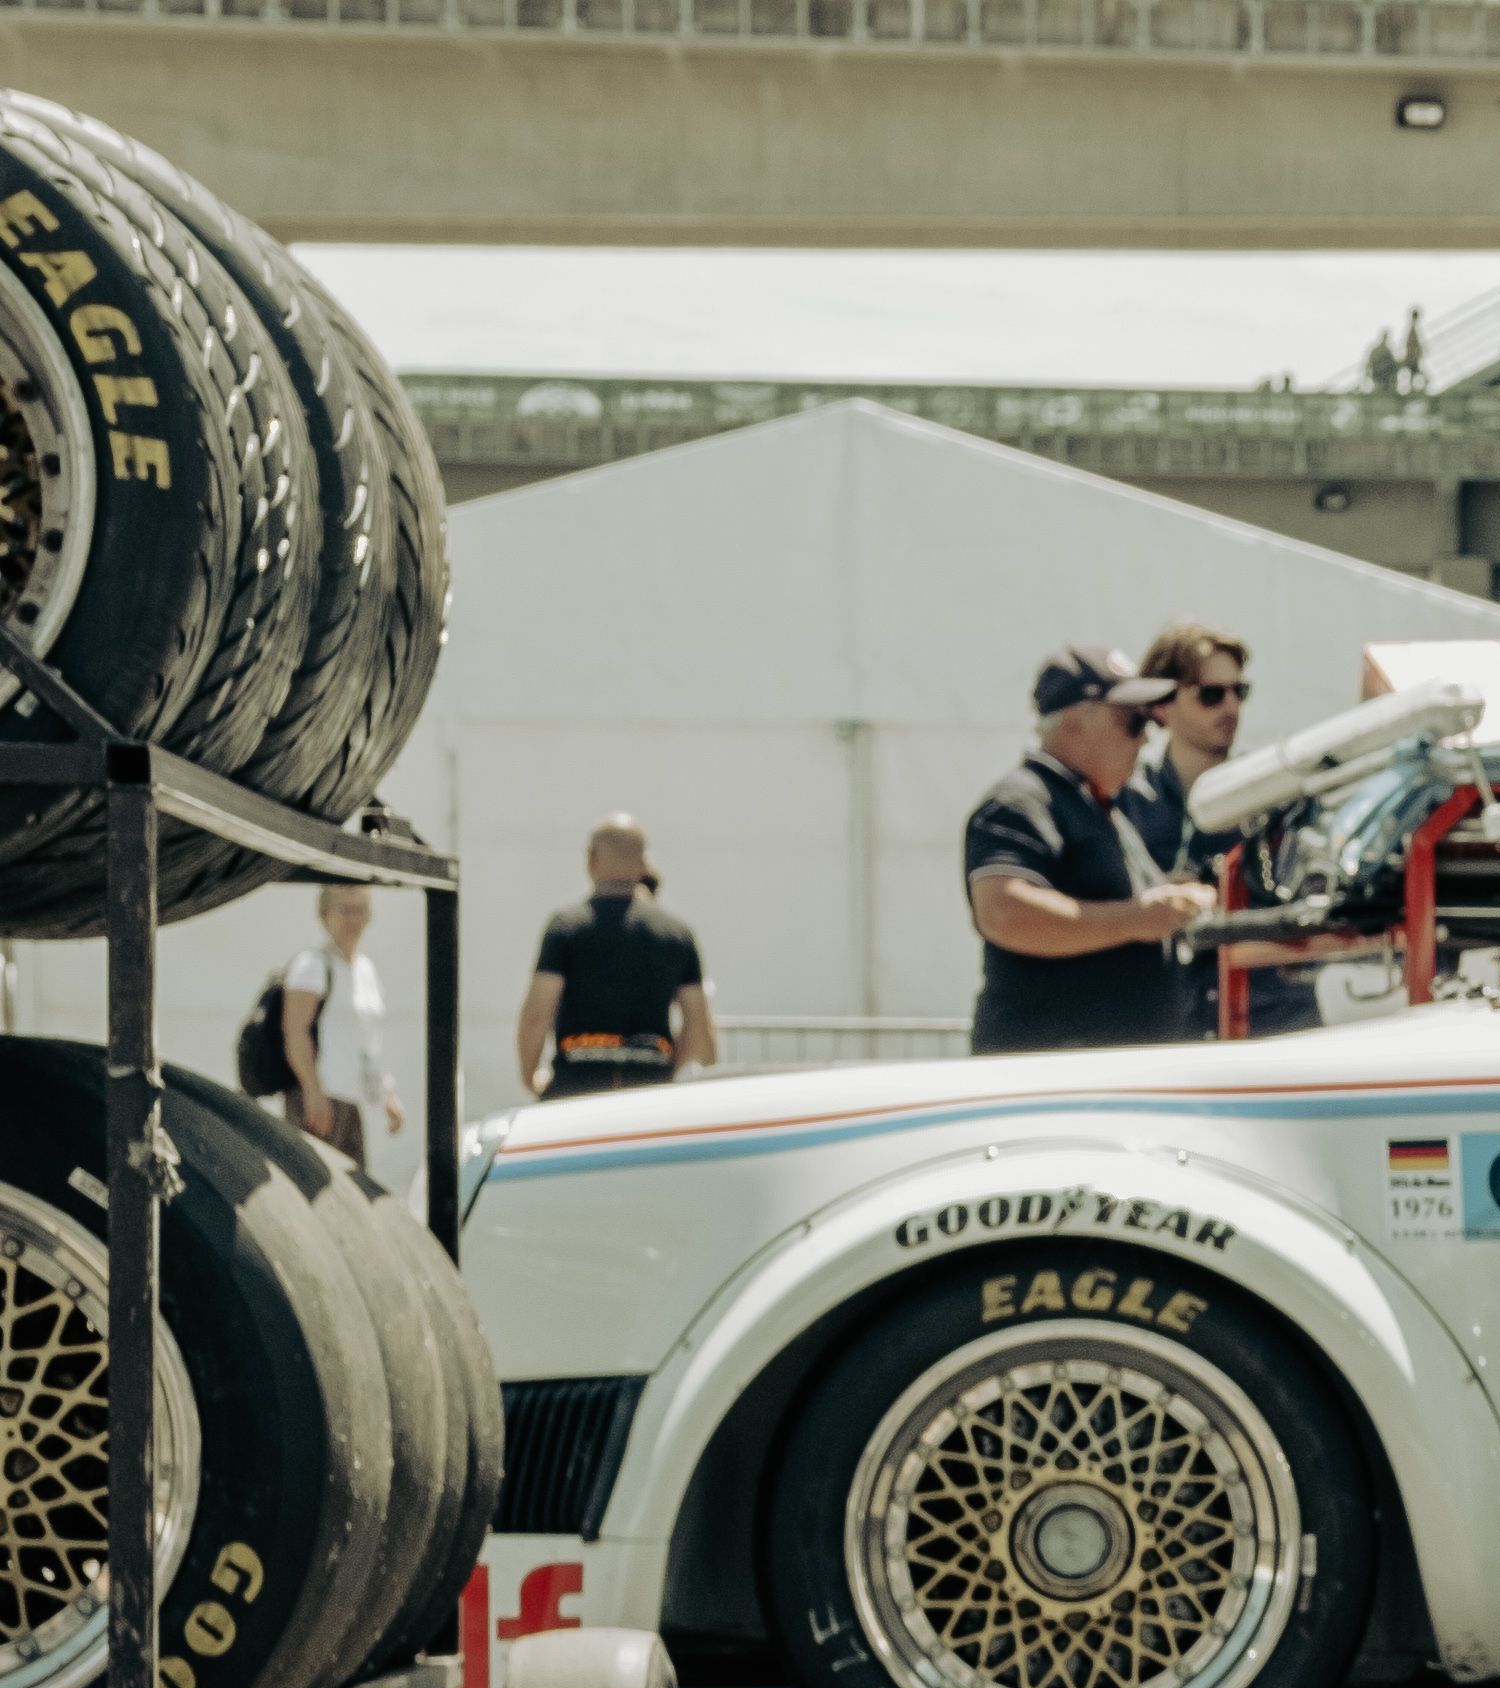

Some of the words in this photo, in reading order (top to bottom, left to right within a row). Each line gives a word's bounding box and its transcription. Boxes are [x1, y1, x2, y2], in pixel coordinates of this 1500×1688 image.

[0, 189, 171, 490] EAGLE
[895, 1184, 1237, 1254] GOODYEAR
[1391, 1198, 1453, 1218] 1976
[981, 1269, 1207, 1335] EAGLE
